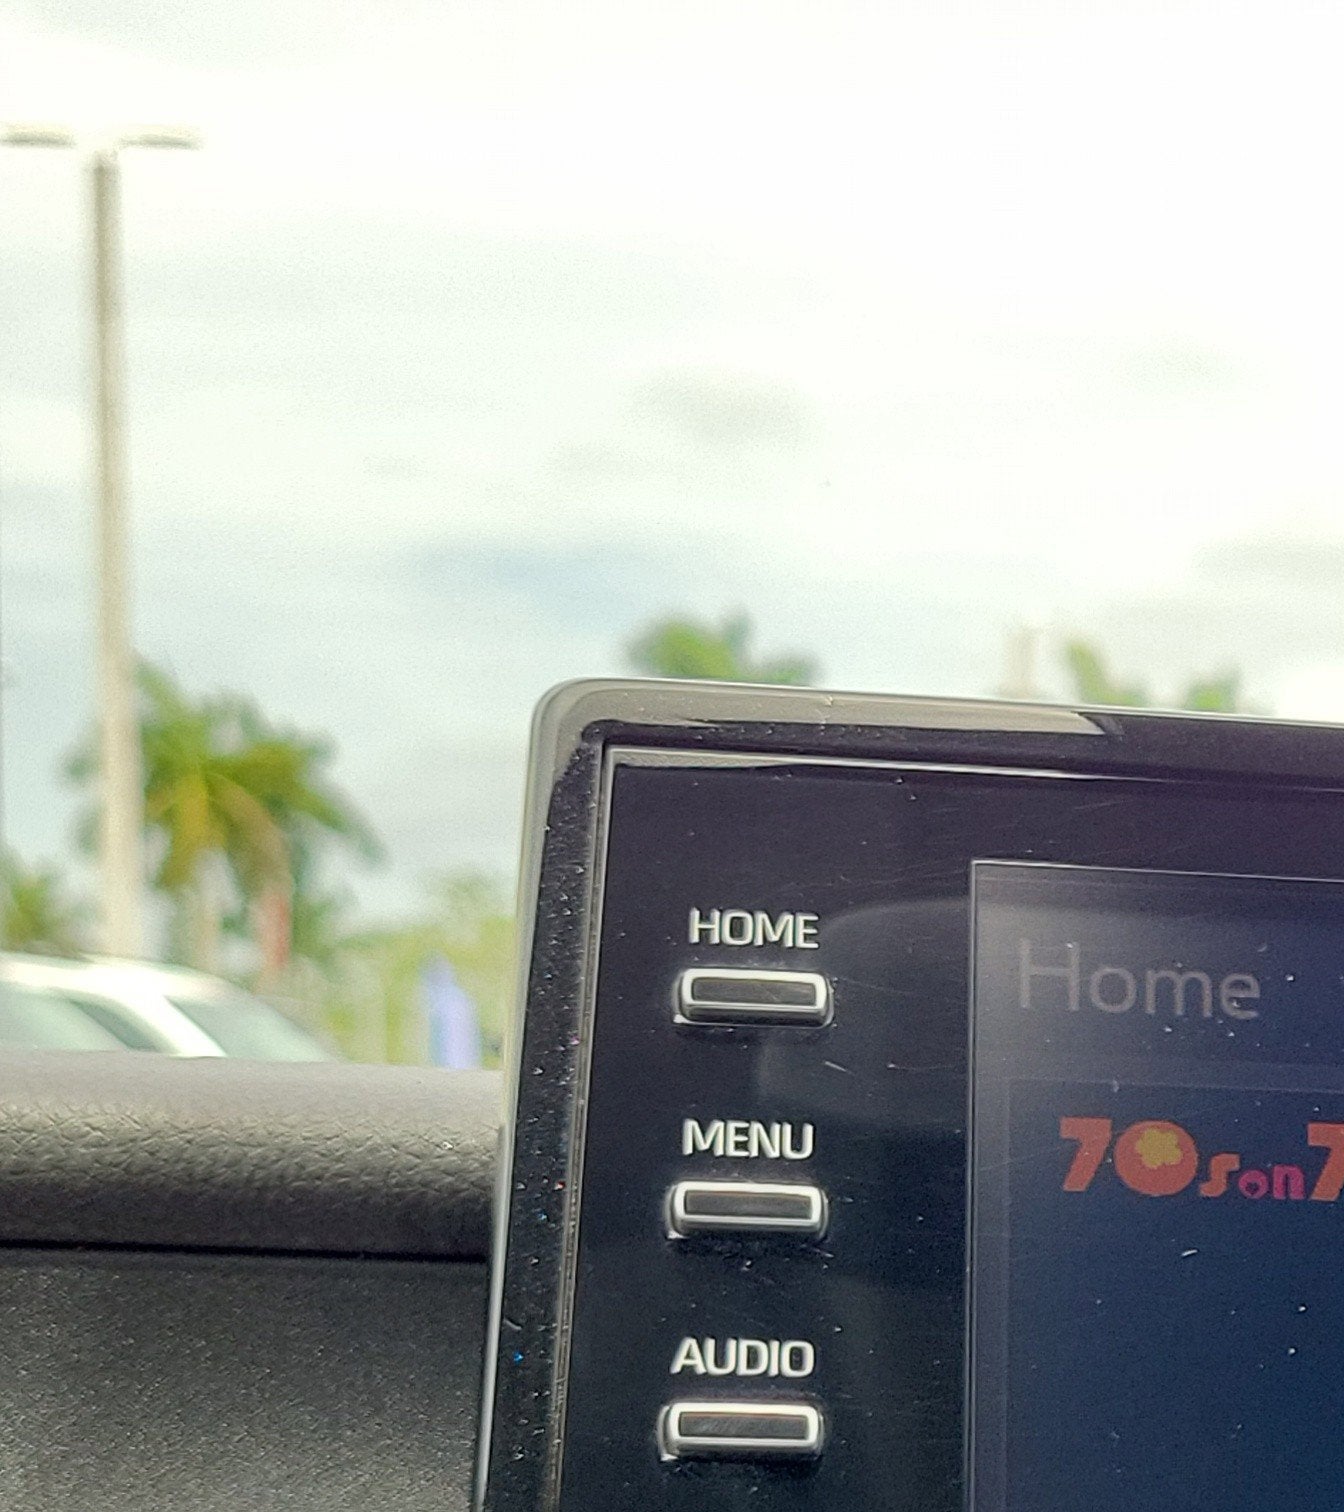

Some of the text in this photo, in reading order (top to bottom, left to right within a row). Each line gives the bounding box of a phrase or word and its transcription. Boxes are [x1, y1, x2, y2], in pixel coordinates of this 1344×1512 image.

[689, 908, 819, 950] HOME
[1017, 937, 1261, 1020] Home
[683, 1118, 815, 1160] MENU
[671, 1337, 815, 1378] AUDIO
